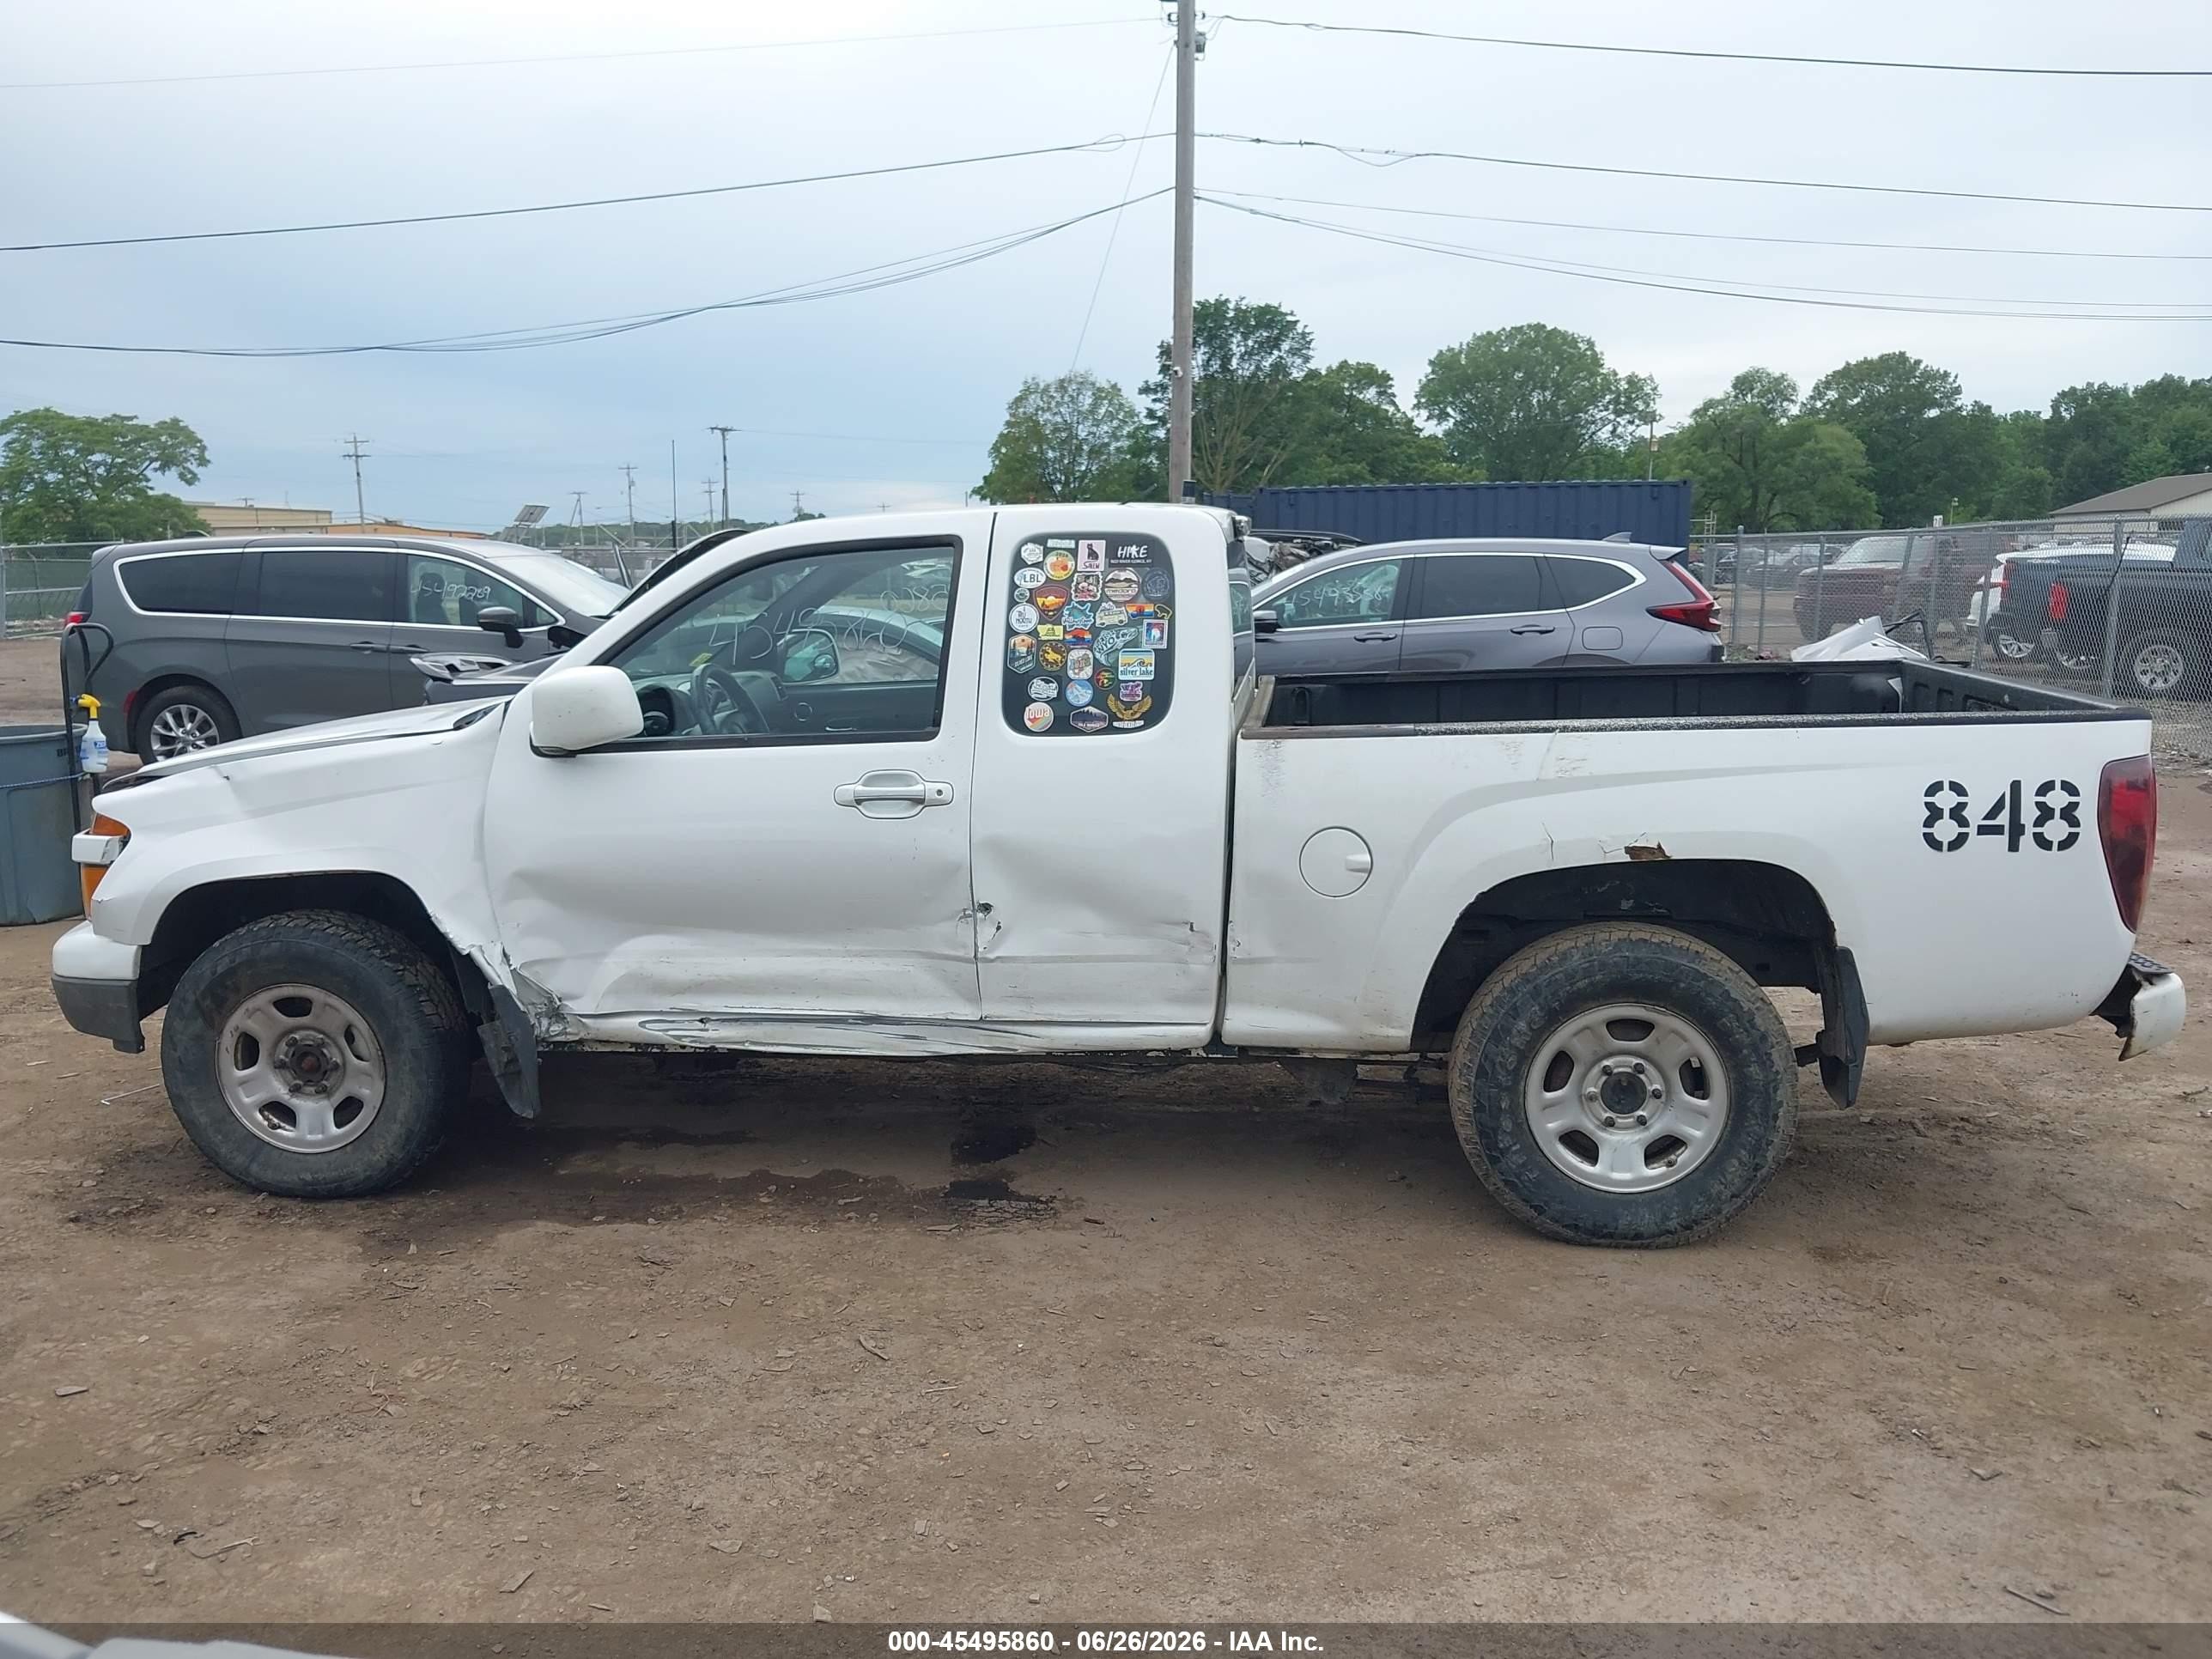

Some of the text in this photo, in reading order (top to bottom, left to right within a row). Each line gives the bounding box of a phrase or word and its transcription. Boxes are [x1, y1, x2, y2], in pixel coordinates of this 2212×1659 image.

[1117, 544, 1148, 559] HIKE
[1024, 574, 1042, 583] LBL
[1139, 667, 1153, 676] lake
[1923, 779, 2081, 852] 848
